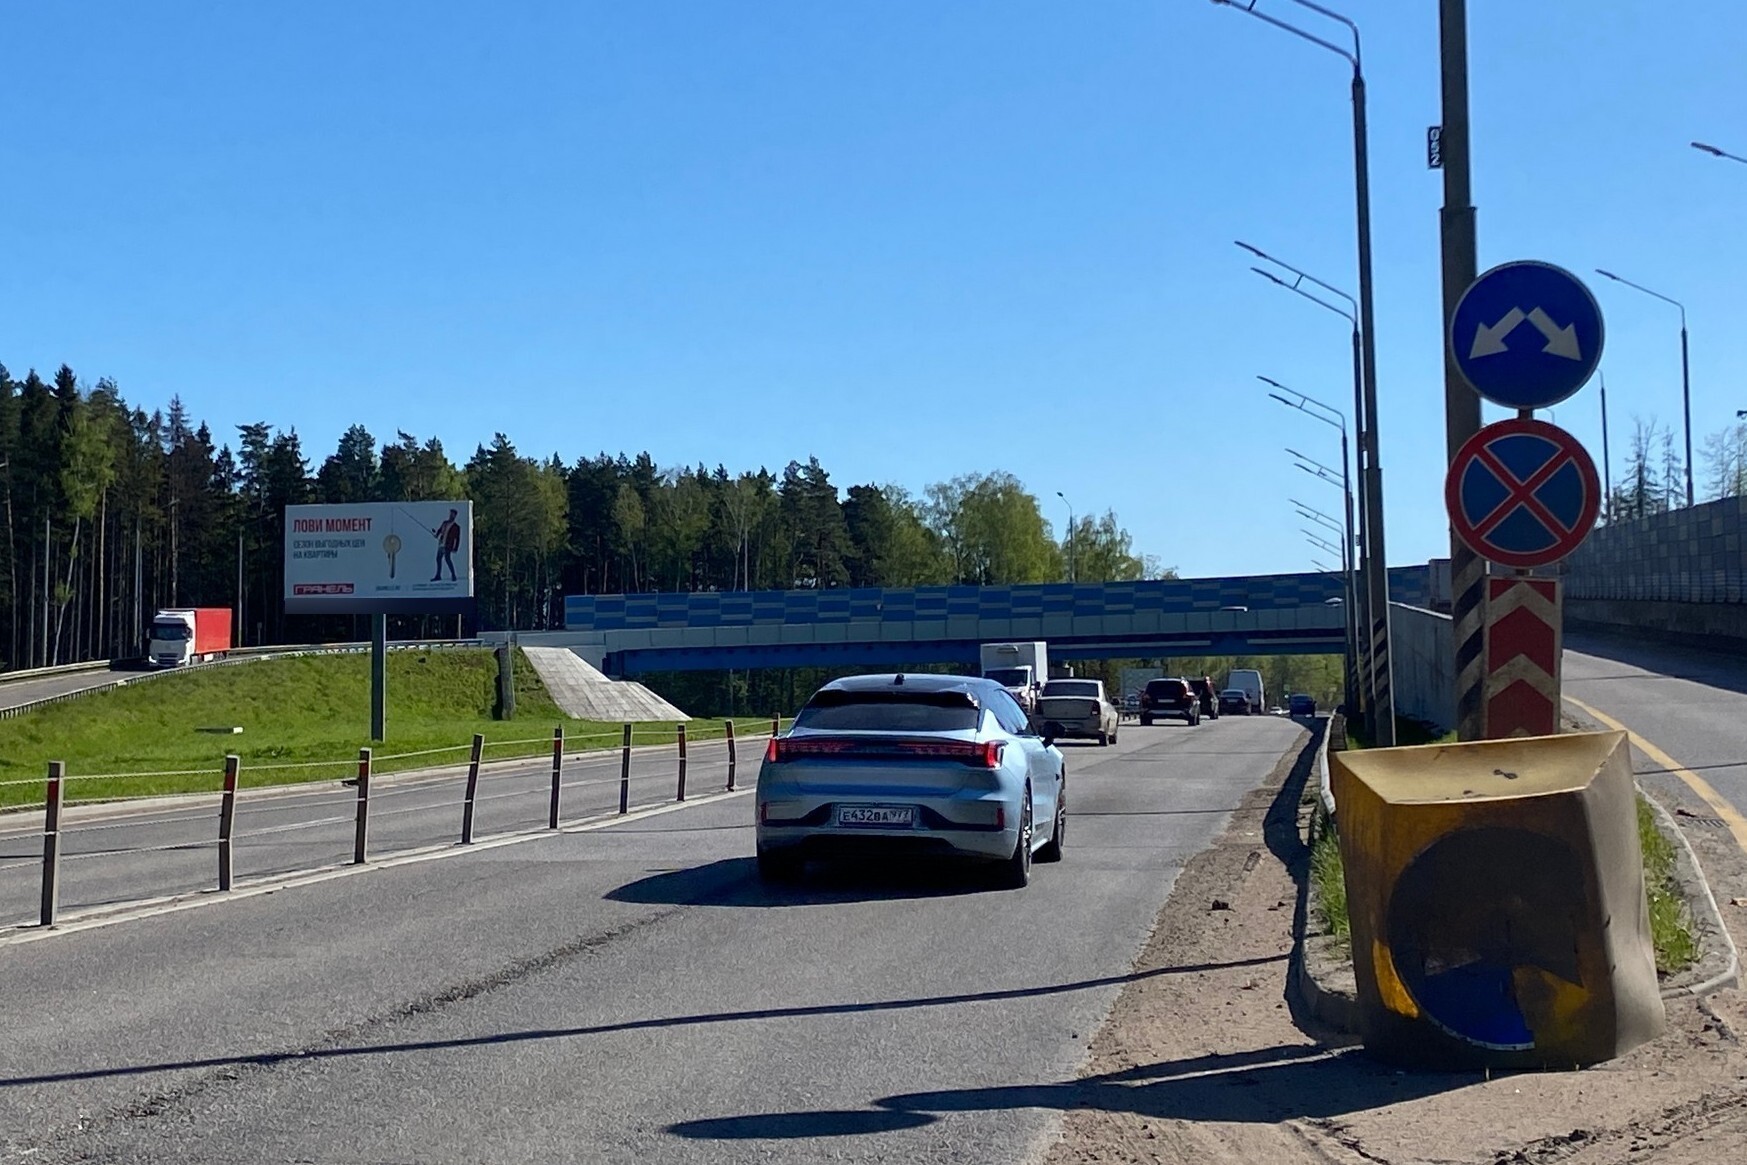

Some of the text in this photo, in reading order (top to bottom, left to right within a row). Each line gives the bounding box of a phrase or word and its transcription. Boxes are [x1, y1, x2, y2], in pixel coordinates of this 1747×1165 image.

[293, 518, 372, 533] ЛОВИ МОМЕНТ
[293, 540, 314, 549] СЕЗОН
[315, 539, 350, 549] ВЫГОДНЫХ
[293, 550, 338, 559] НА КВАРТИРЫ
[295, 585, 353, 594] ГРАНЕЛЬ
